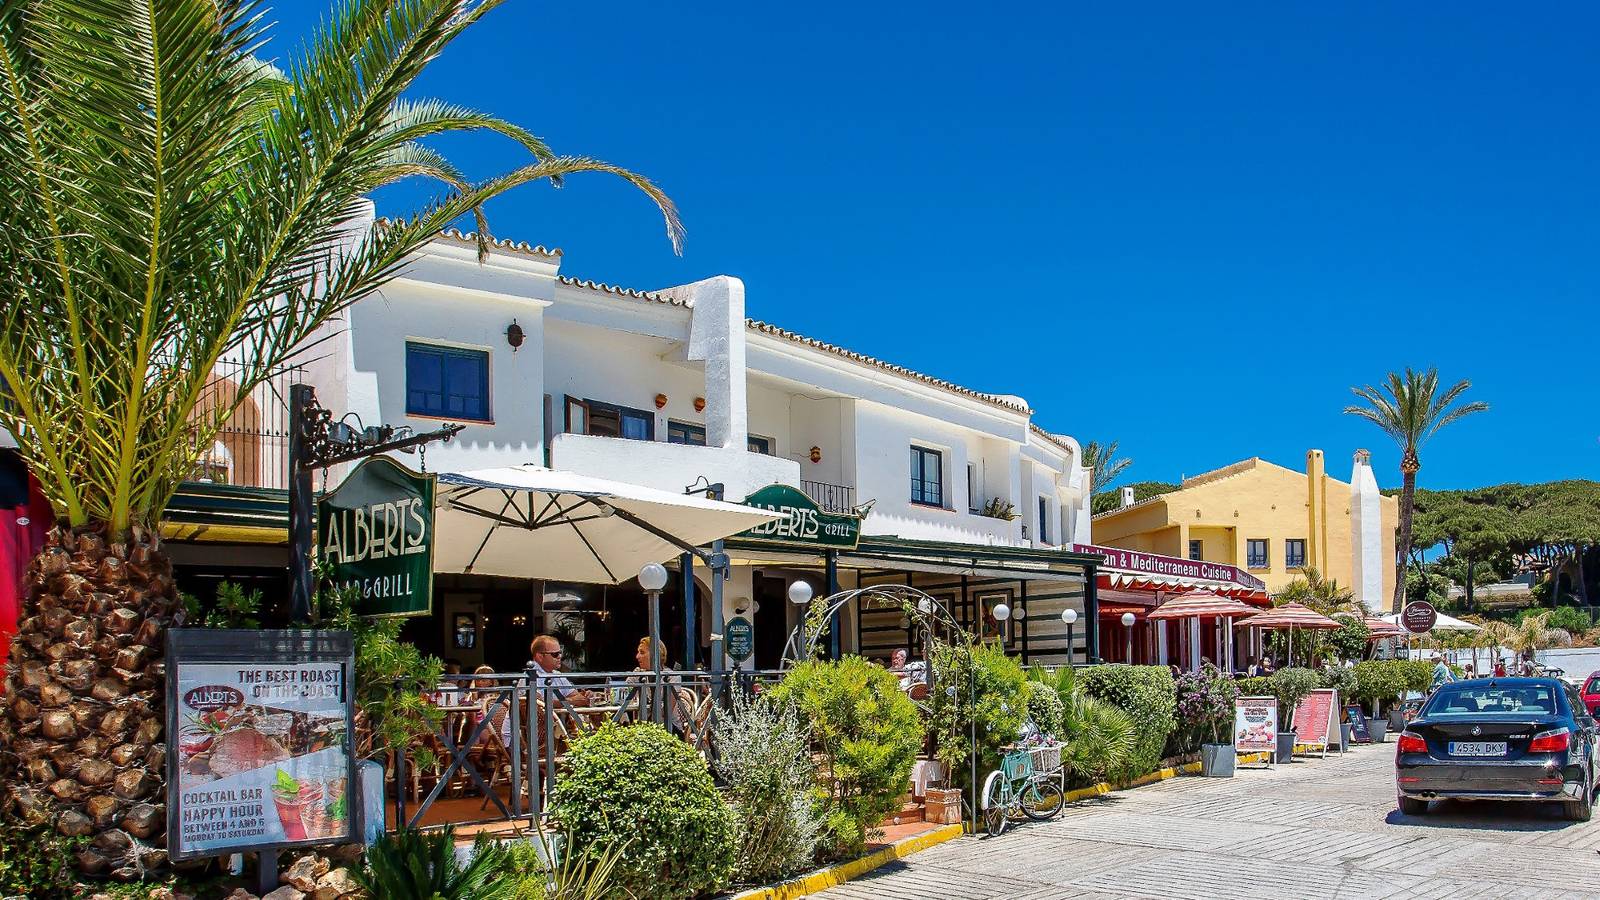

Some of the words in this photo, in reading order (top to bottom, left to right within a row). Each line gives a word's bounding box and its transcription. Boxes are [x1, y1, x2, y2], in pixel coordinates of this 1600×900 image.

[747, 502, 819, 538] LBERTS
[825, 523, 850, 537] GRILL
[324, 498, 426, 564] ALBERTS
[1120, 553, 1127, 568] &
[1131, 554, 1199, 577] Mediterranean
[1201, 564, 1232, 581] Cuisine
[238, 670, 262, 683] THE
[266, 670, 298, 683] BEST
[301, 669, 341, 683] ROAST
[1457, 743, 1481, 753] 4534
[183, 790, 238, 805] COCKTAIL
[241, 788, 263, 800] BAR
[183, 807, 226, 822] HAPPY
[230, 804, 264, 818] HOUR
[183, 820, 228, 834] BETWEEN
[230, 820, 237, 829] 4
[239, 818, 257, 829] AND
[184, 832, 215, 843] MONDAY
[218, 831, 227, 840] TO
[229, 828, 265, 839] SATURDAY
